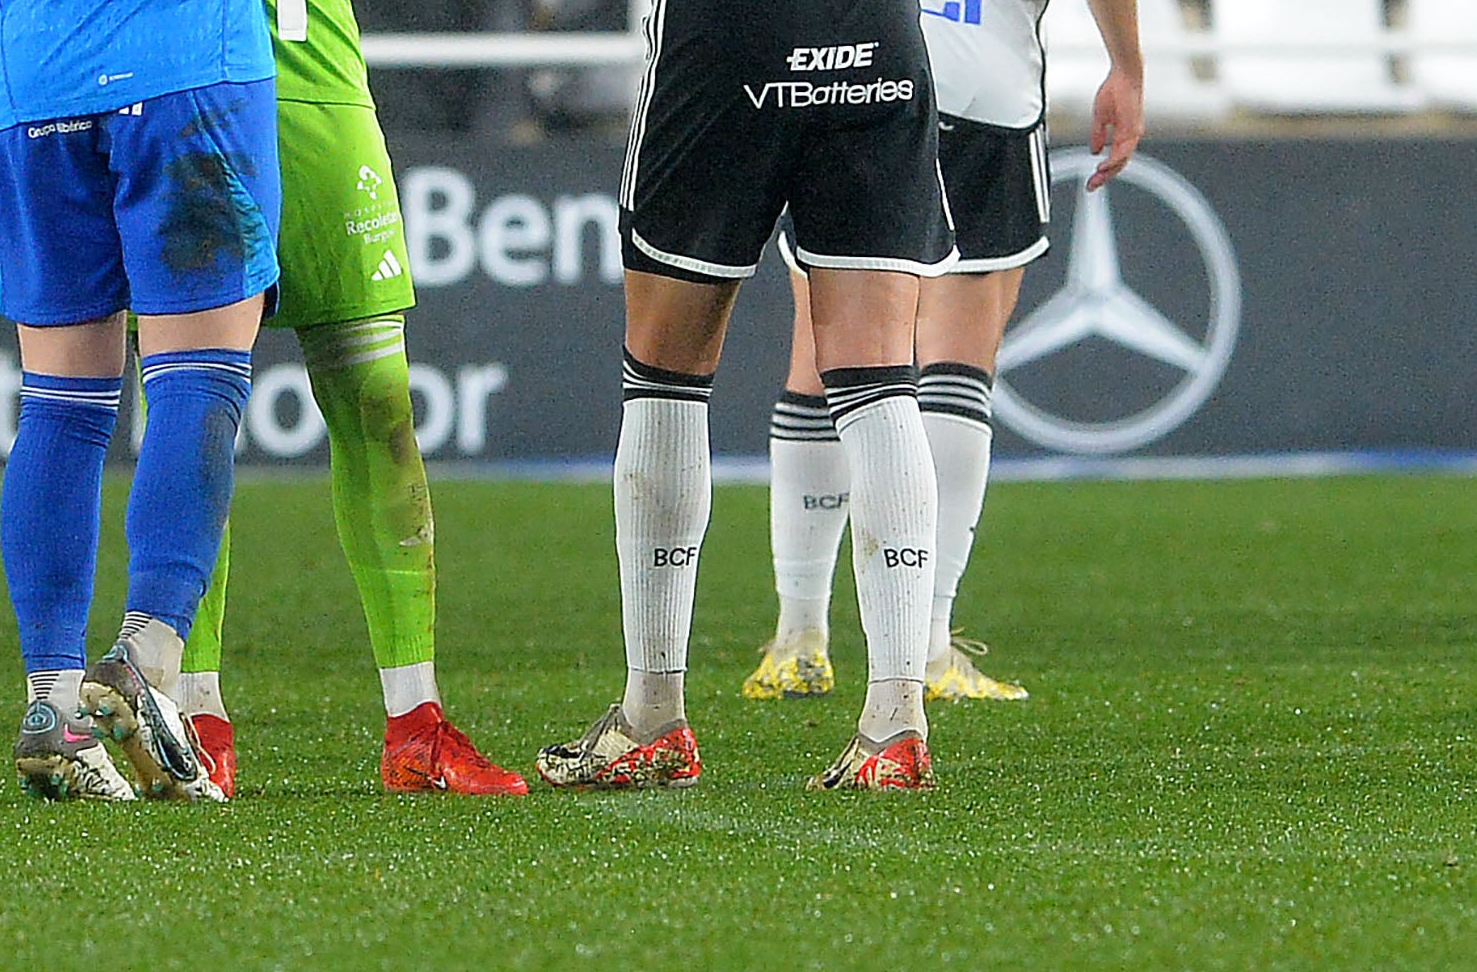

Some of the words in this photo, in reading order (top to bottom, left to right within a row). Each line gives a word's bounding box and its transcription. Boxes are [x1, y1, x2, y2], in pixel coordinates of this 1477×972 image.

[787, 42, 874, 72] EXIDE
[743, 77, 914, 109] VTBatteries
[403, 166, 624, 288] Ben
[803, 492, 850, 510] BCF
[653, 547, 697, 567] BCF
[884, 548, 928, 569] BCF
